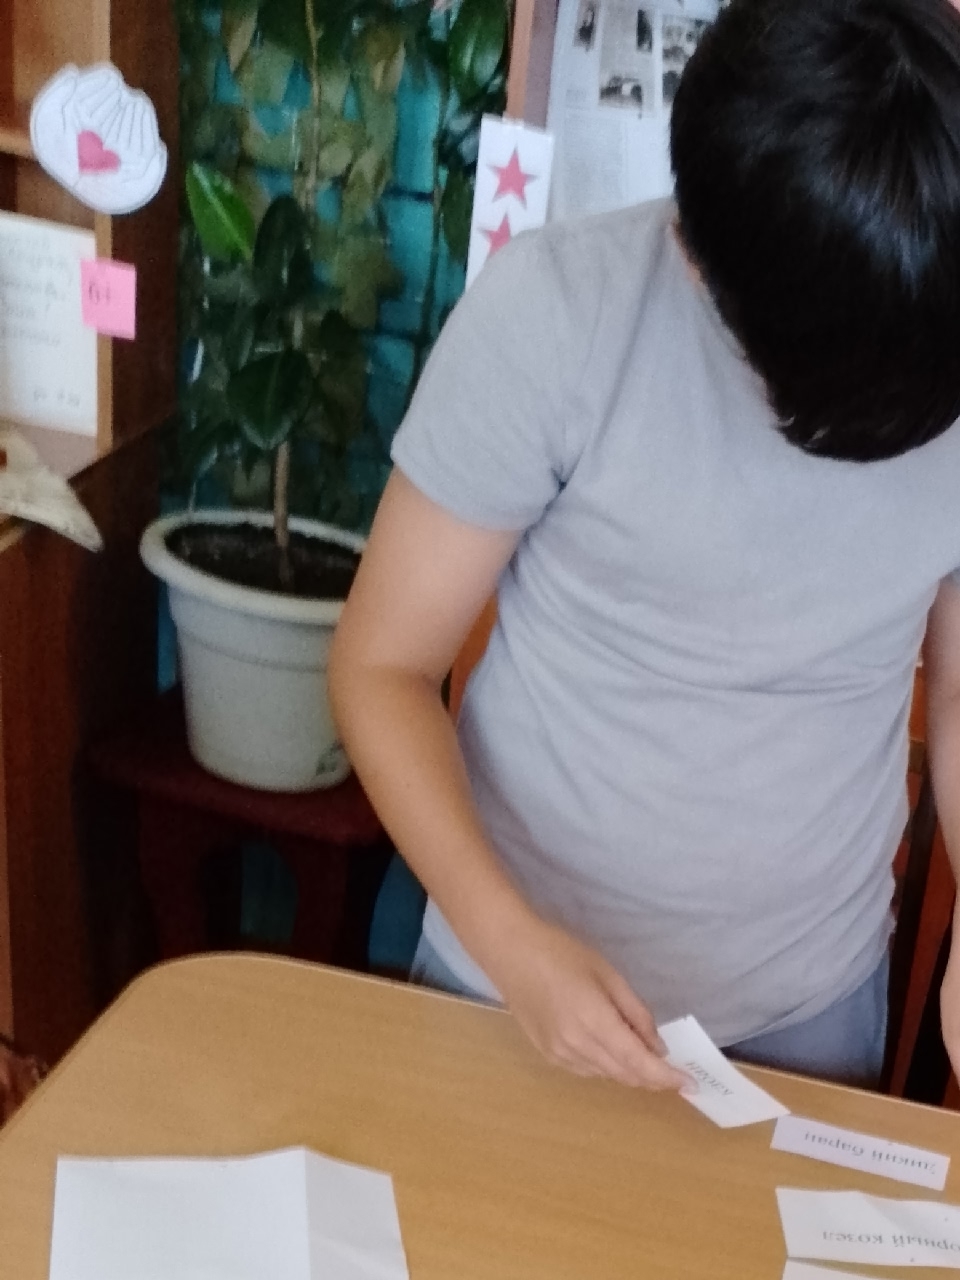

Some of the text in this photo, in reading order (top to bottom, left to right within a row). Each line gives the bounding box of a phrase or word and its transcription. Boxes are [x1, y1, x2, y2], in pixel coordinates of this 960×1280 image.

[804, 1131, 937, 1175] дикий баран
[823, 1230, 884, 1246] козел
